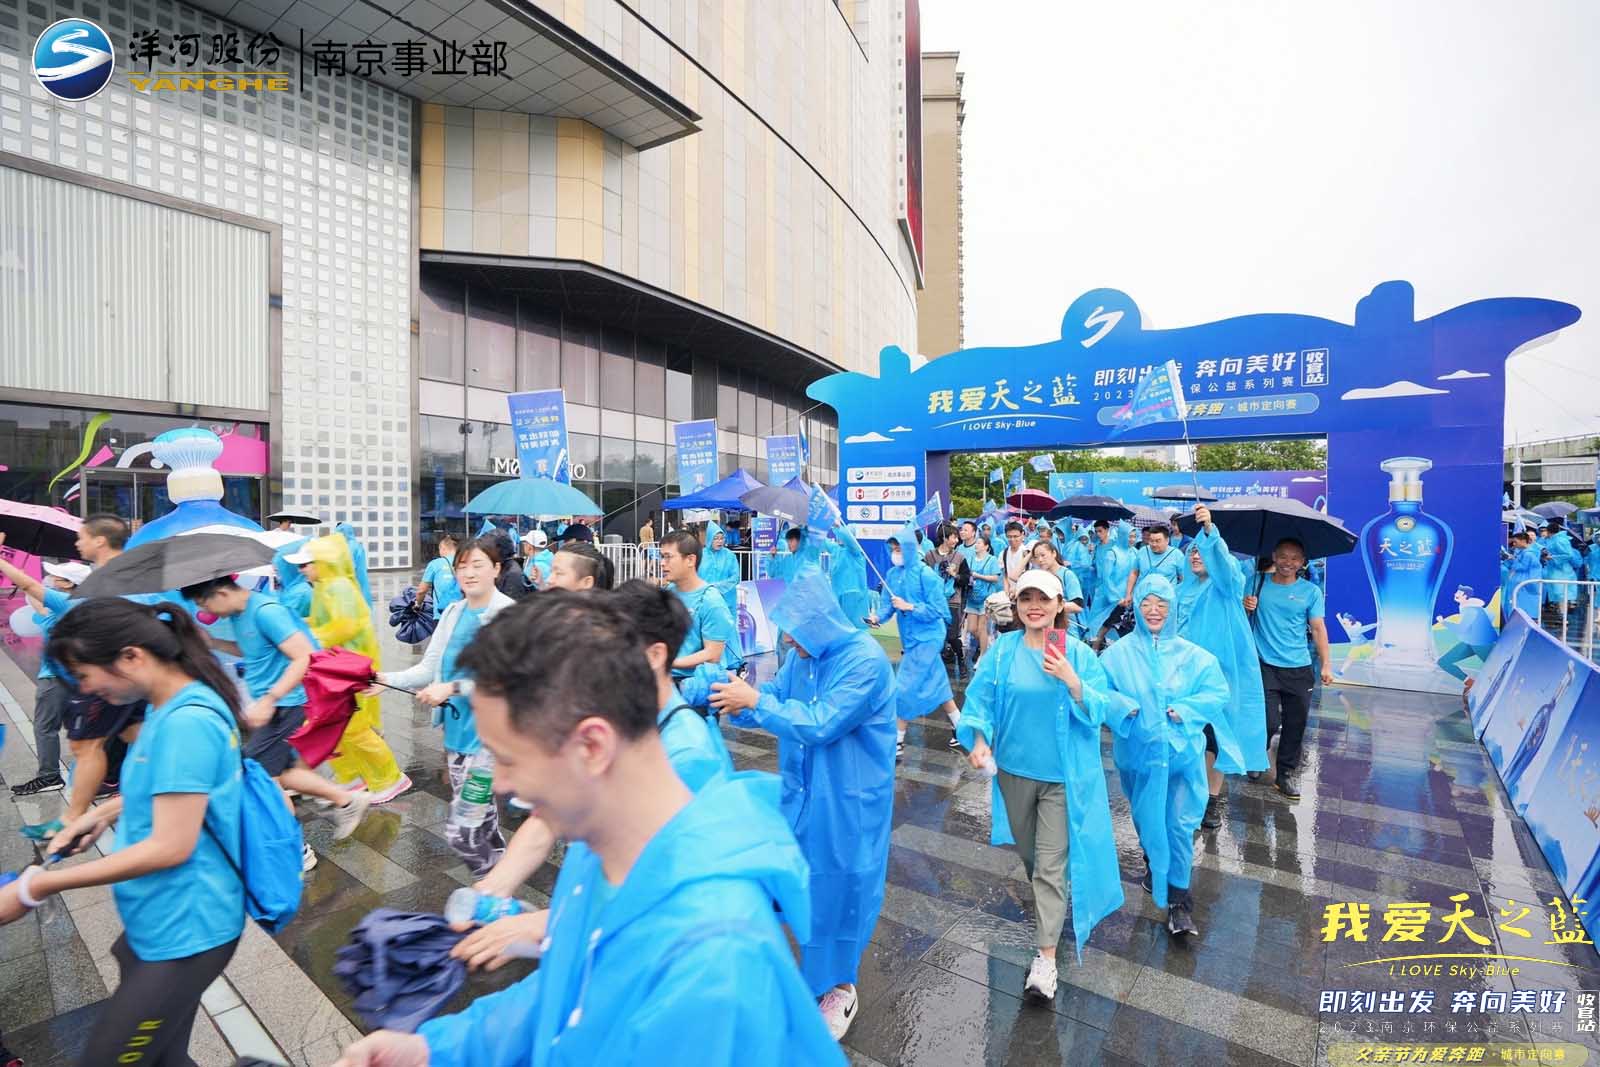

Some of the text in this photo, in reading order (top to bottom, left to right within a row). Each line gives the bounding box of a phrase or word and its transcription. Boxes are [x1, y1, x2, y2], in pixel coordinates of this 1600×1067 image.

[1195, 351, 1297, 379] 奔向美好
[968, 421, 993, 431] LOVE
[995, 420, 1037, 431] Sky-Blue
